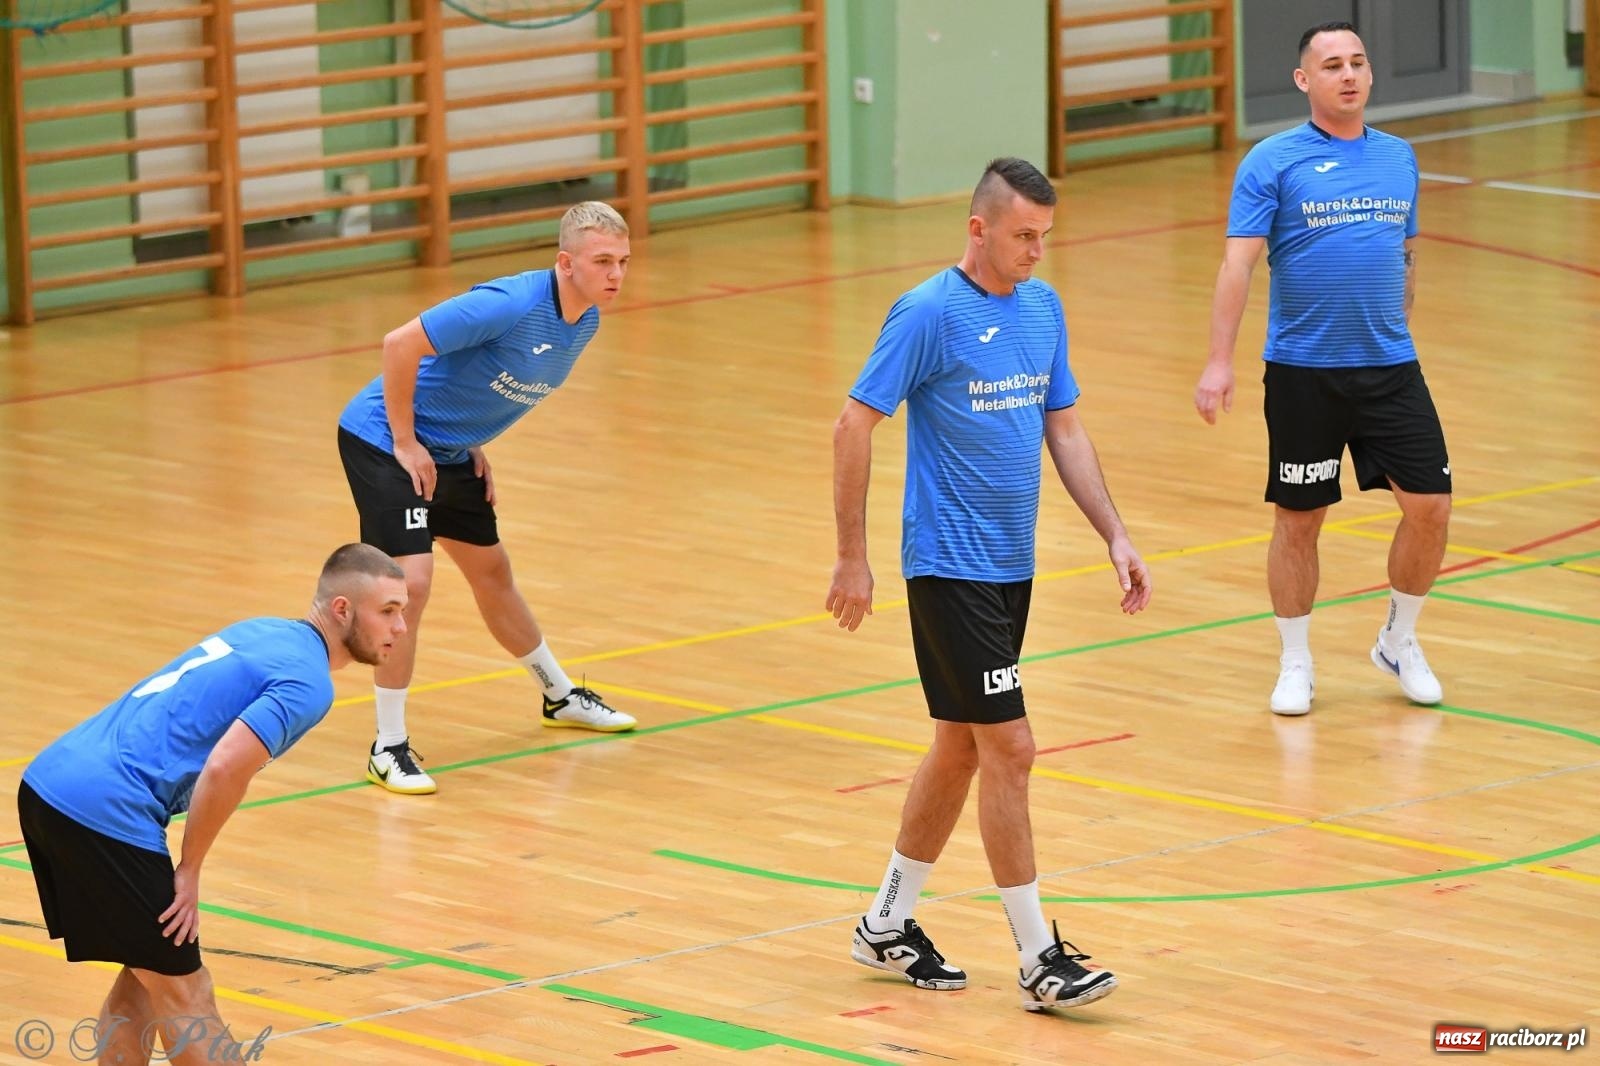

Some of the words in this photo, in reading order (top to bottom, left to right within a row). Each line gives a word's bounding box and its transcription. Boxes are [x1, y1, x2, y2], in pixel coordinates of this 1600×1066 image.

[1301, 197, 1411, 215] Marek&Dariusz
[1307, 212, 1371, 229] Metallbau
[1280, 461, 1305, 485] LSM
[1304, 459, 1340, 484] SPORT
[131, 636, 234, 699] 7
[882, 867, 903, 911] PROSKARY
